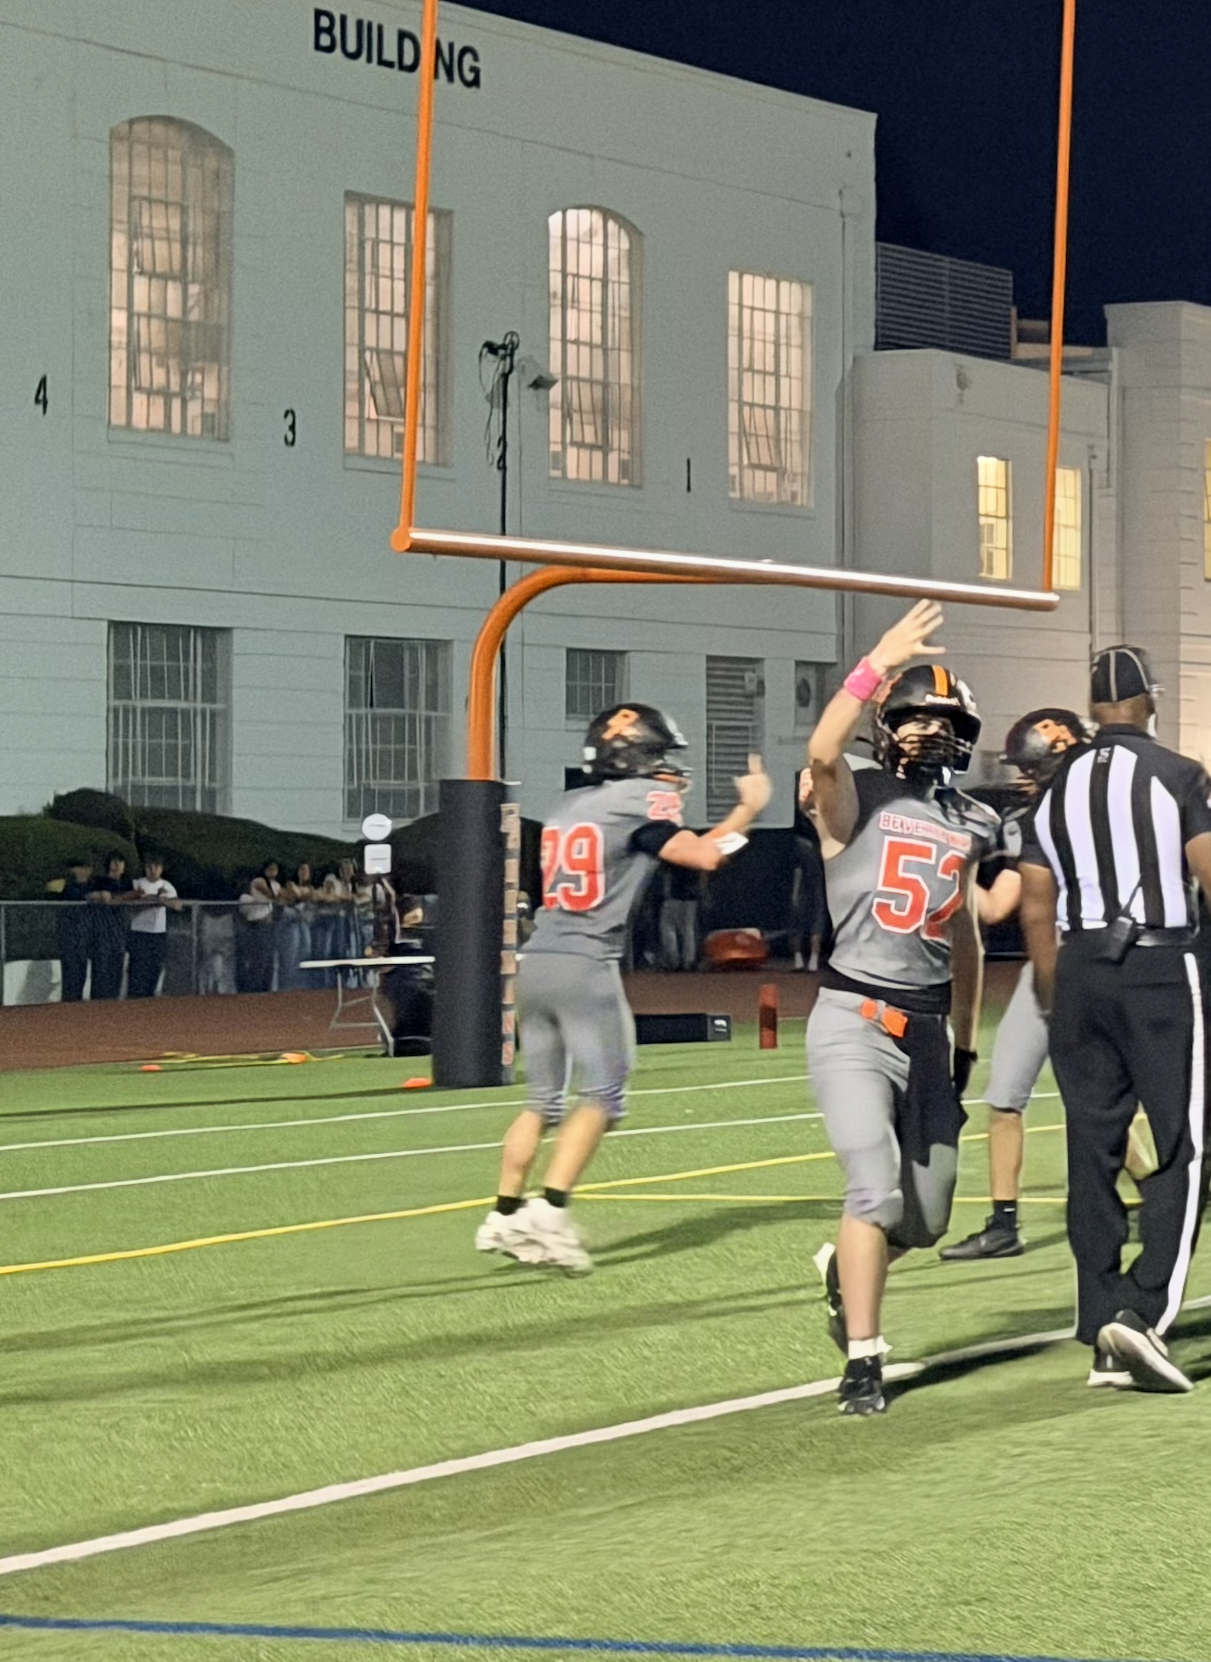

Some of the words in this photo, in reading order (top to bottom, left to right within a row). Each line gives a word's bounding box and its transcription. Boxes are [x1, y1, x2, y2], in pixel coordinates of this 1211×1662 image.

[313, 7, 481, 89] BUILDNG
[34, 373, 48, 416] 4
[283, 408, 296, 447] 3
[871, 835, 967, 943] 52
